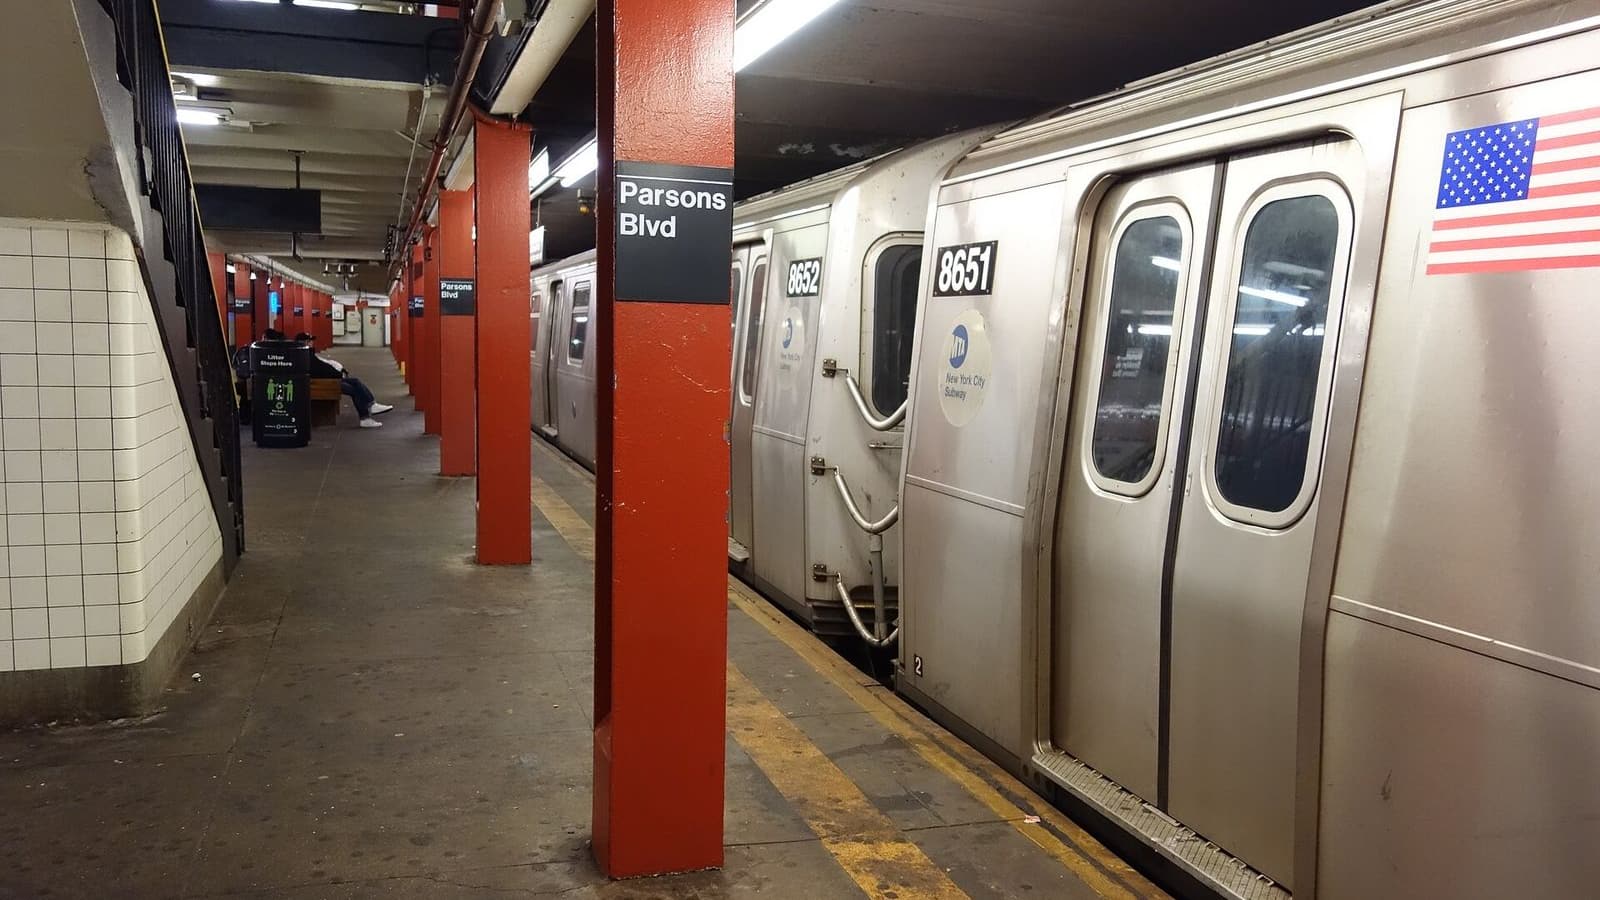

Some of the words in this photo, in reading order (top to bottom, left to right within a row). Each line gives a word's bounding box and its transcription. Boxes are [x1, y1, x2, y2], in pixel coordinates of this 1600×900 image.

[620, 181, 726, 210] Parsons
[620, 212, 676, 238] Blvd
[788, 260, 820, 294] 8652
[938, 246, 991, 292] 8651
[441, 282, 472, 290] Parsons
[945, 372, 958, 384] New
[959, 373, 971, 385] York
[973, 375, 985, 389] City
[944, 386, 967, 401] Subway
[915, 656, 921, 675] 2
